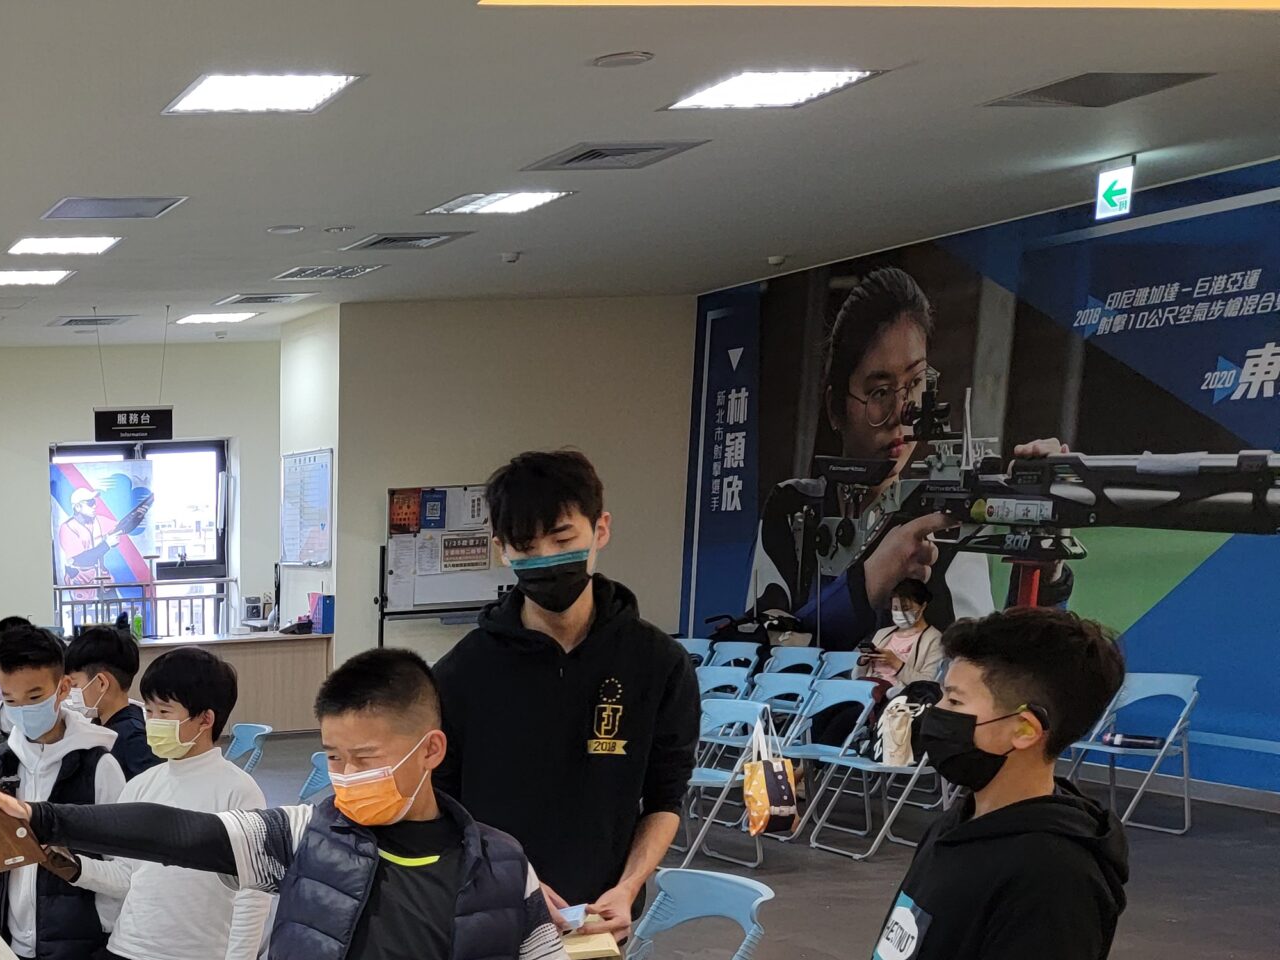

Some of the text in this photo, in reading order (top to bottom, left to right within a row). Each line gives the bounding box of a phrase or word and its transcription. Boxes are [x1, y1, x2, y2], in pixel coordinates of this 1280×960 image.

[1073, 307, 1102, 327] 2018
[1200, 368, 1237, 390] 2020
[116, 412, 151, 425] 服務台
[1004, 534, 1031, 550] 800
